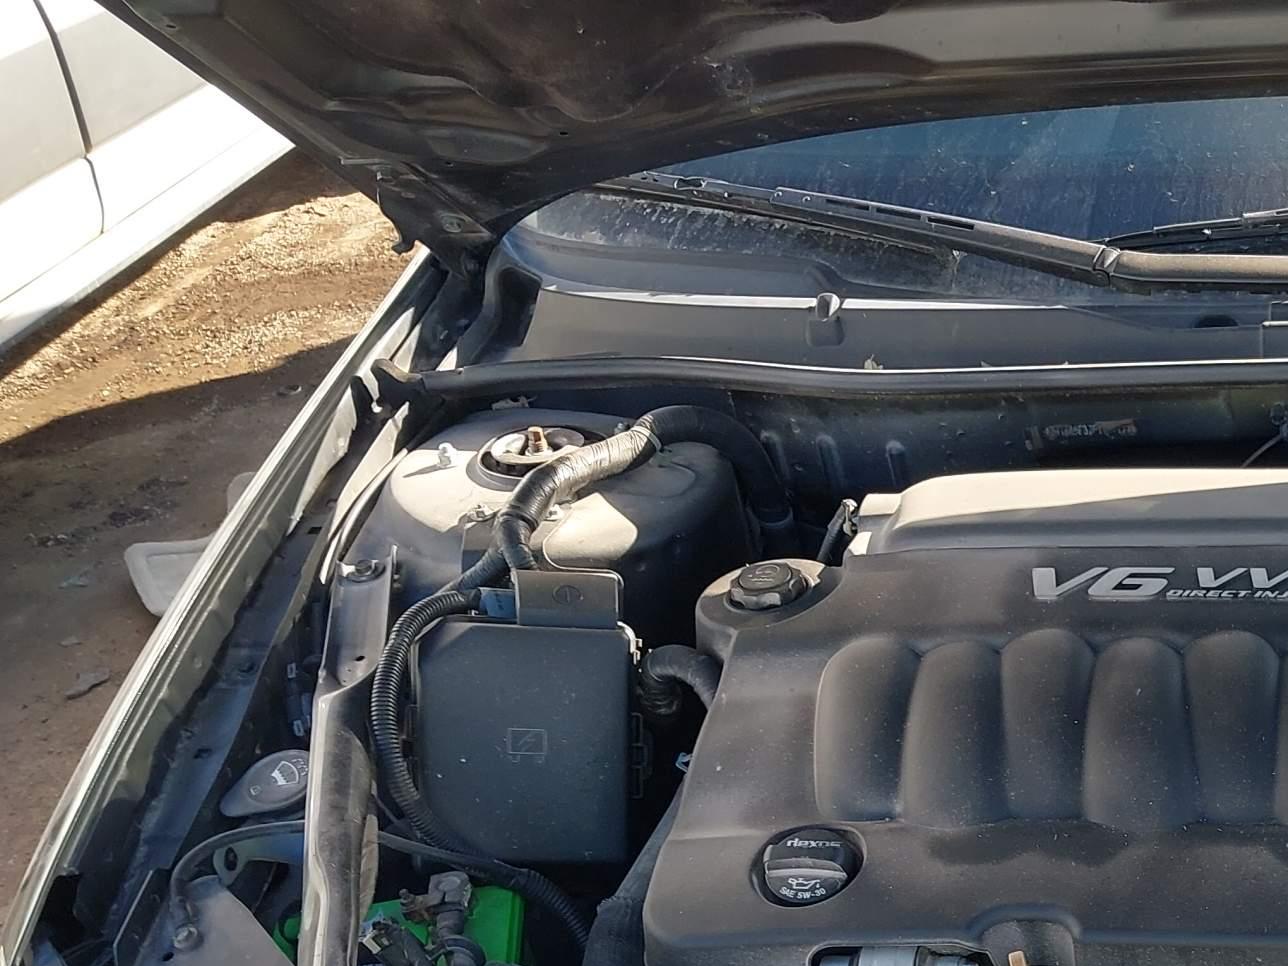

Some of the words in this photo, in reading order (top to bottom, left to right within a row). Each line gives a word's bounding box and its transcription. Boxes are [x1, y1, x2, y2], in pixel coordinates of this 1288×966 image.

[1032, 567, 1175, 599] V6
[1167, 590, 1251, 598] DIRECT
[780, 887, 796, 897] SAE
[797, 887, 826, 899] 5W-30
